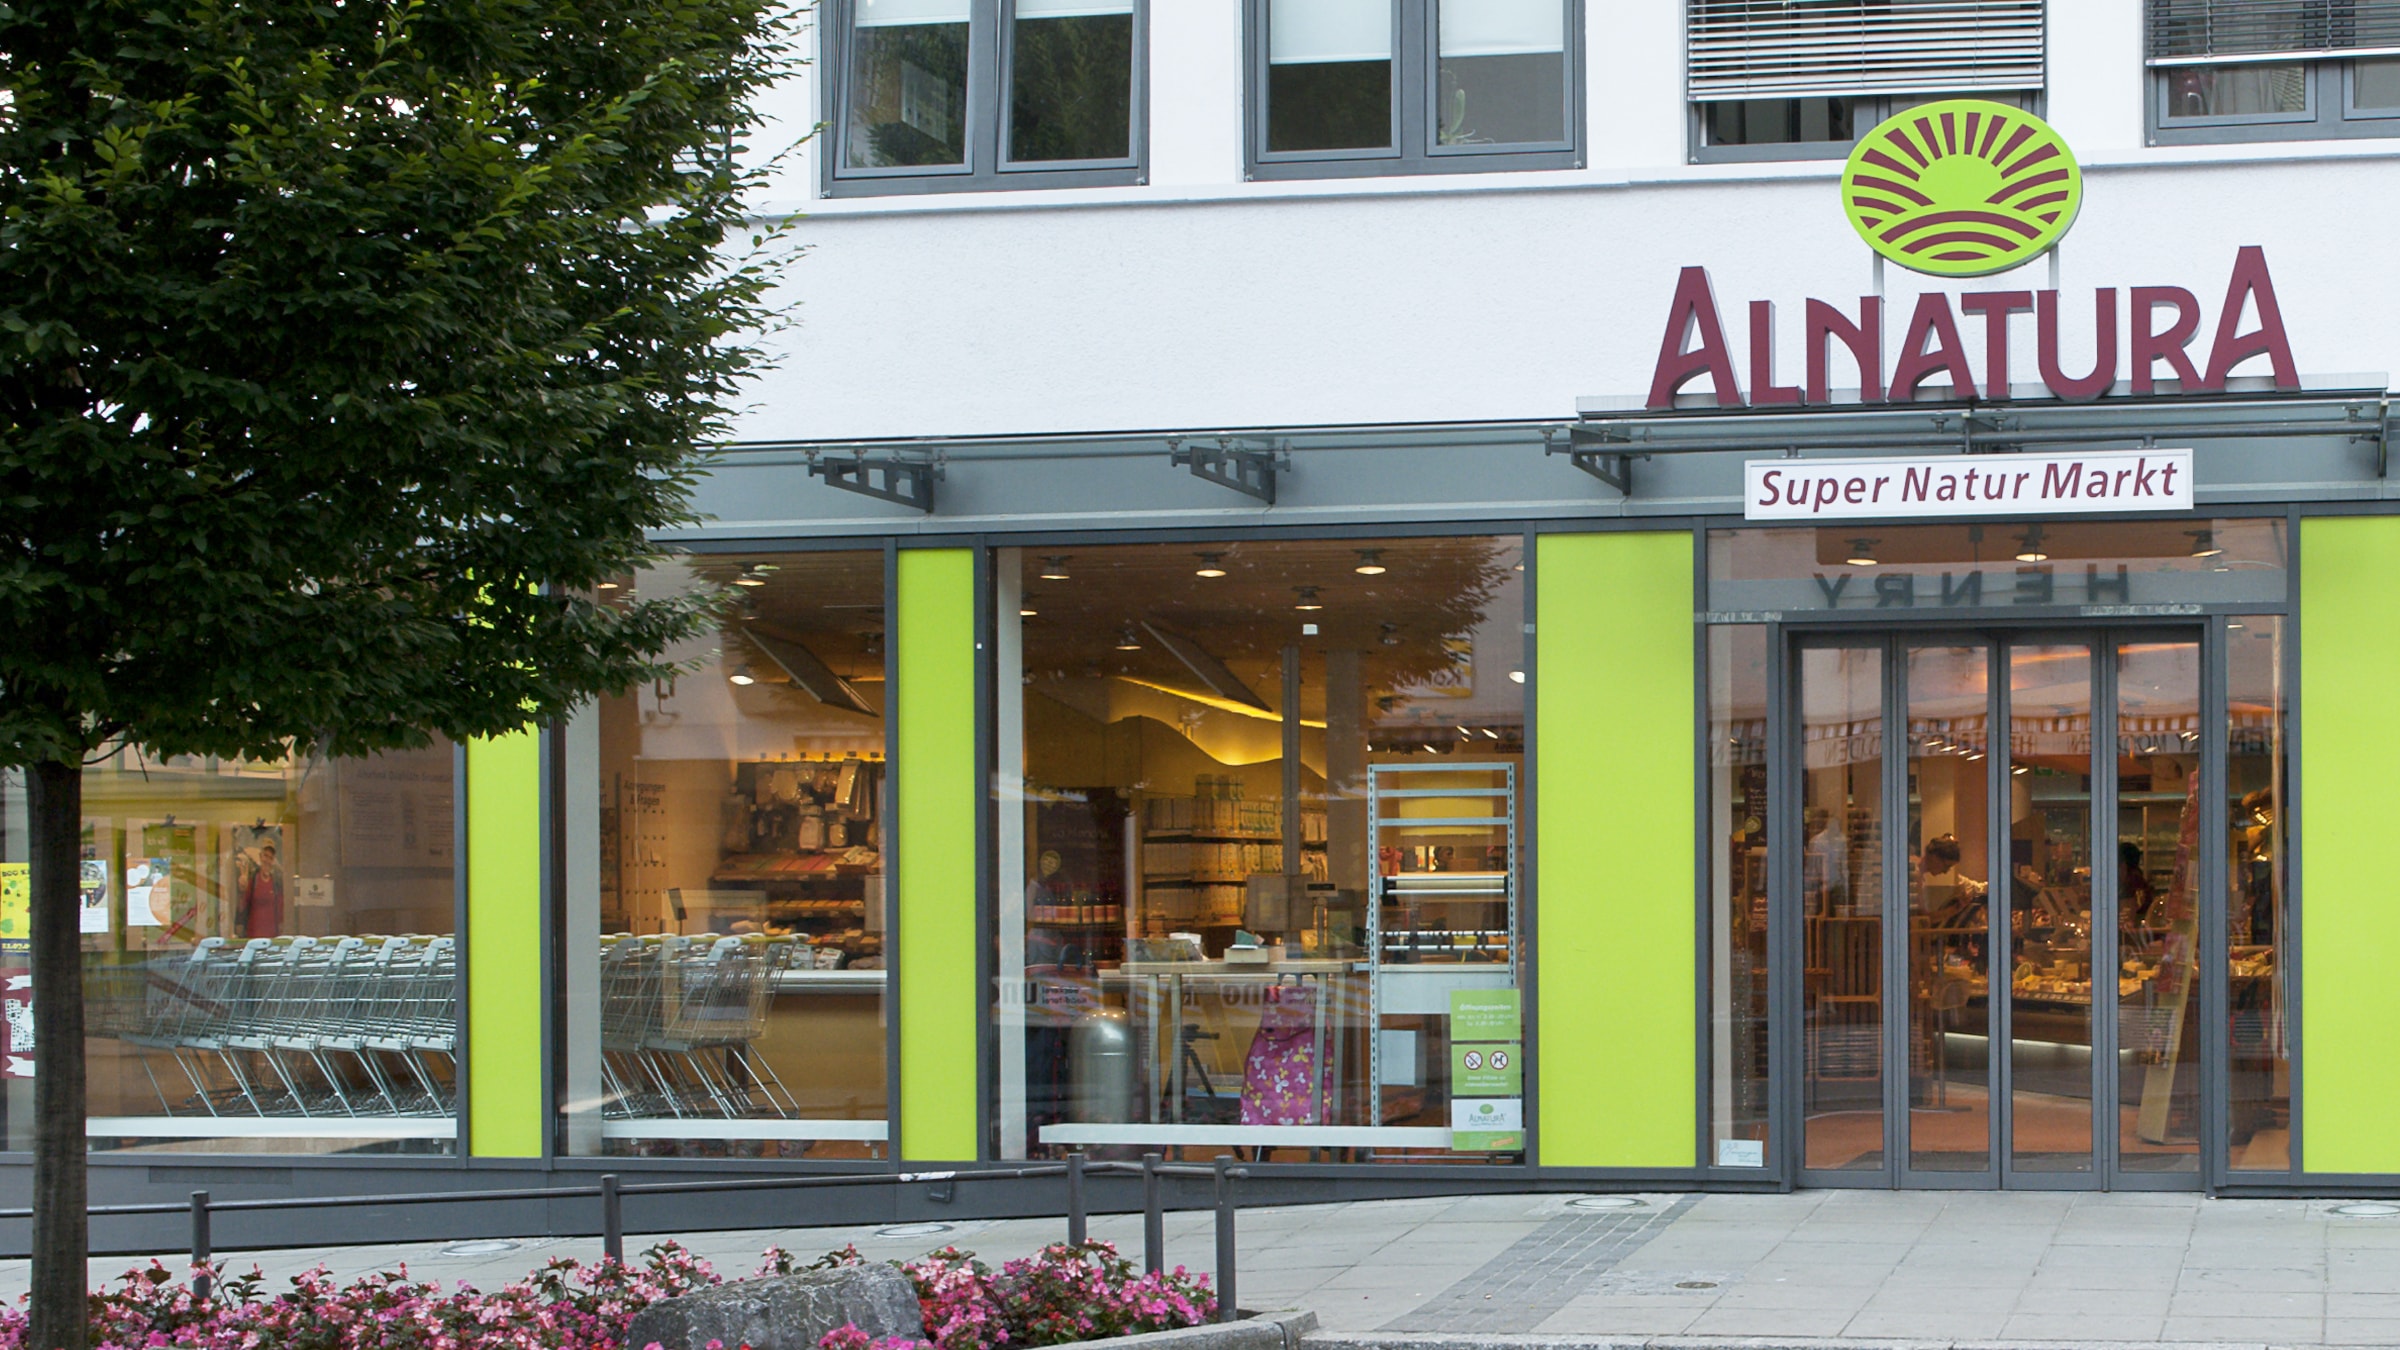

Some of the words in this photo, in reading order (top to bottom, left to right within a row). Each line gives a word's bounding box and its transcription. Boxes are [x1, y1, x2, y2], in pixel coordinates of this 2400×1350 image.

[1645, 245, 2302, 411] ALNATURA
[1758, 469, 1890, 513] Super
[1901, 466, 2030, 502] Natur
[2040, 457, 2178, 500] Markt
